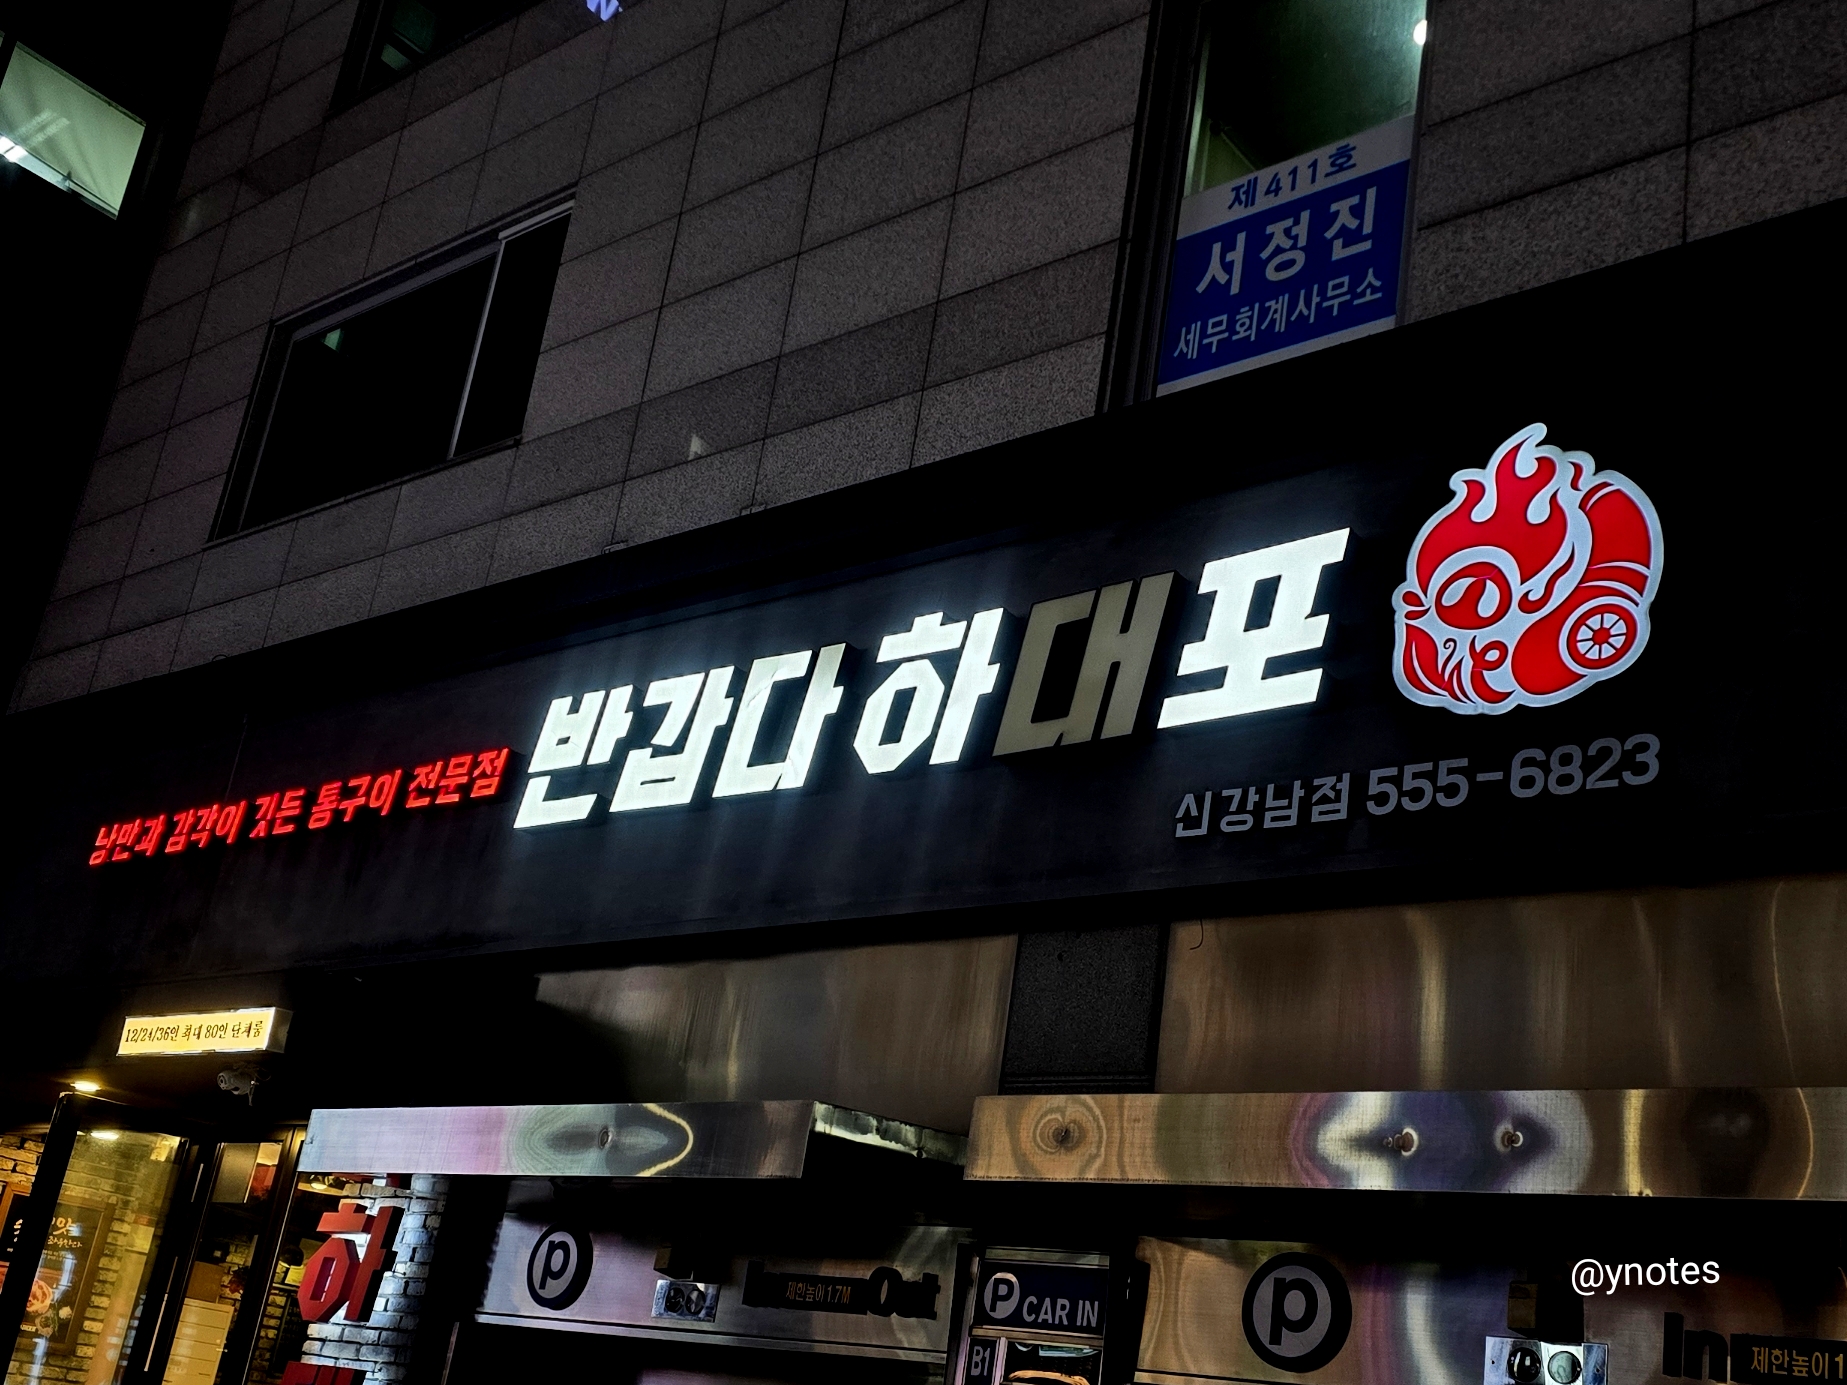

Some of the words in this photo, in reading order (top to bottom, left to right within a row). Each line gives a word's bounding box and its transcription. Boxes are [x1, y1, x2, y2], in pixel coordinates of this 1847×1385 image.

[1228, 143, 1356, 210] 제411호
[1196, 186, 1377, 295] 서정진
[1173, 267, 1383, 359] 세무회계사무소
[513, 642, 848, 829] 반갑다
[853, 527, 1350, 774] 하대포
[89, 814, 165, 865] 낭만과
[165, 801, 247, 853] 감각이
[249, 788, 306, 838] 깃든
[308, 769, 403, 829] 통구이
[406, 748, 509, 808] 전문점
[1175, 773, 1350, 838] 신강남점
[1366, 733, 1661, 816] 555-6823
[125, 1025, 180, 1043] 12/24/36인
[182, 1023, 203, 1041] 최대
[205, 1022, 229, 1039] 80인
[231, 1020, 263, 1038] 단체룸
[785, 1281, 824, 1302] 제한높이
[826, 1284, 852, 1305] 1.7M
[1022, 1296, 1070, 1325] CAR
[1076, 1300, 1099, 1327] IN
[970, 1346, 991, 1376] B1
[1750, 1346, 1829, 1380] 제한높이
